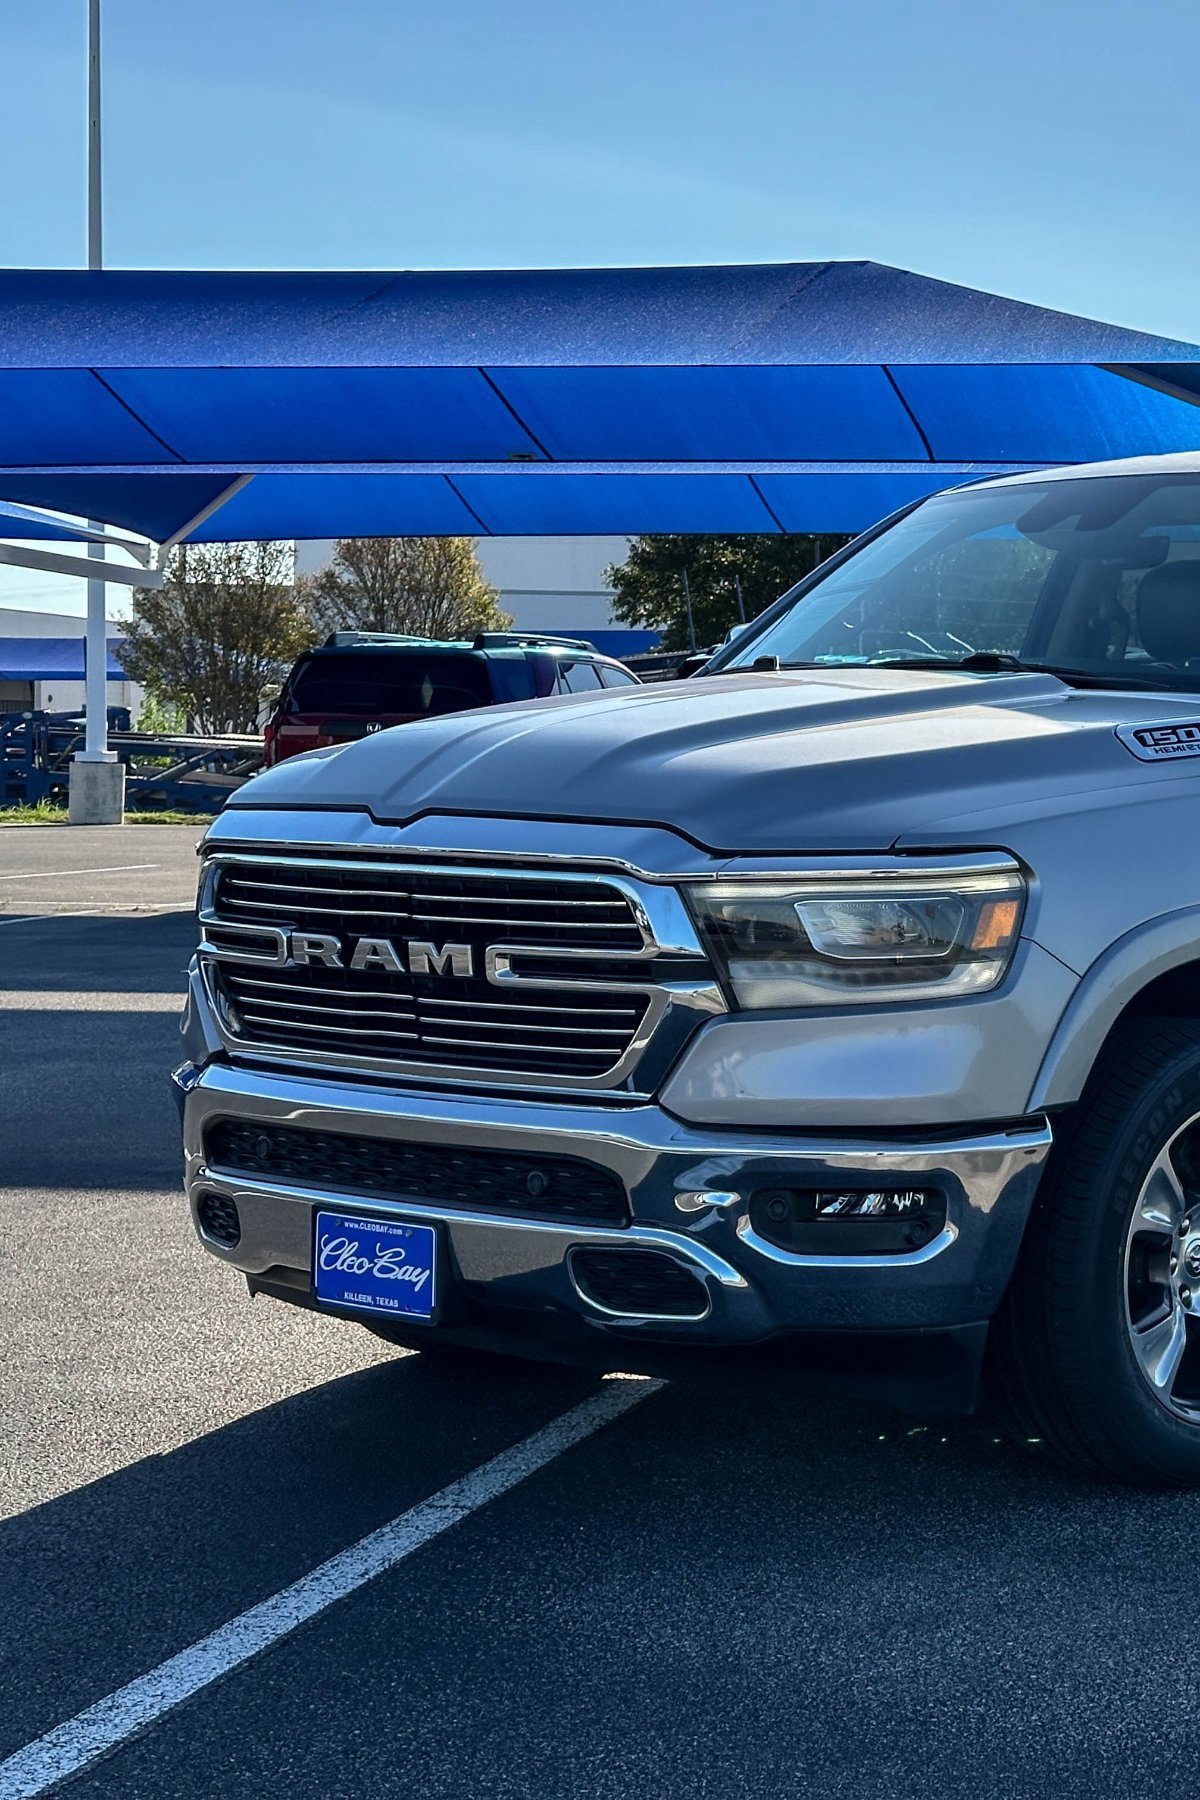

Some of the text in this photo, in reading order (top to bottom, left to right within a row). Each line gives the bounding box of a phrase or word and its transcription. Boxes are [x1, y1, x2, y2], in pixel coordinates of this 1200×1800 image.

[1153, 745, 1187, 755] HEMI
[291, 931, 474, 977] RAM
[344, 1220, 403, 1236] www.CLEOBAY.com
[343, 1291, 399, 1308] KILLEEN, TEXAS
